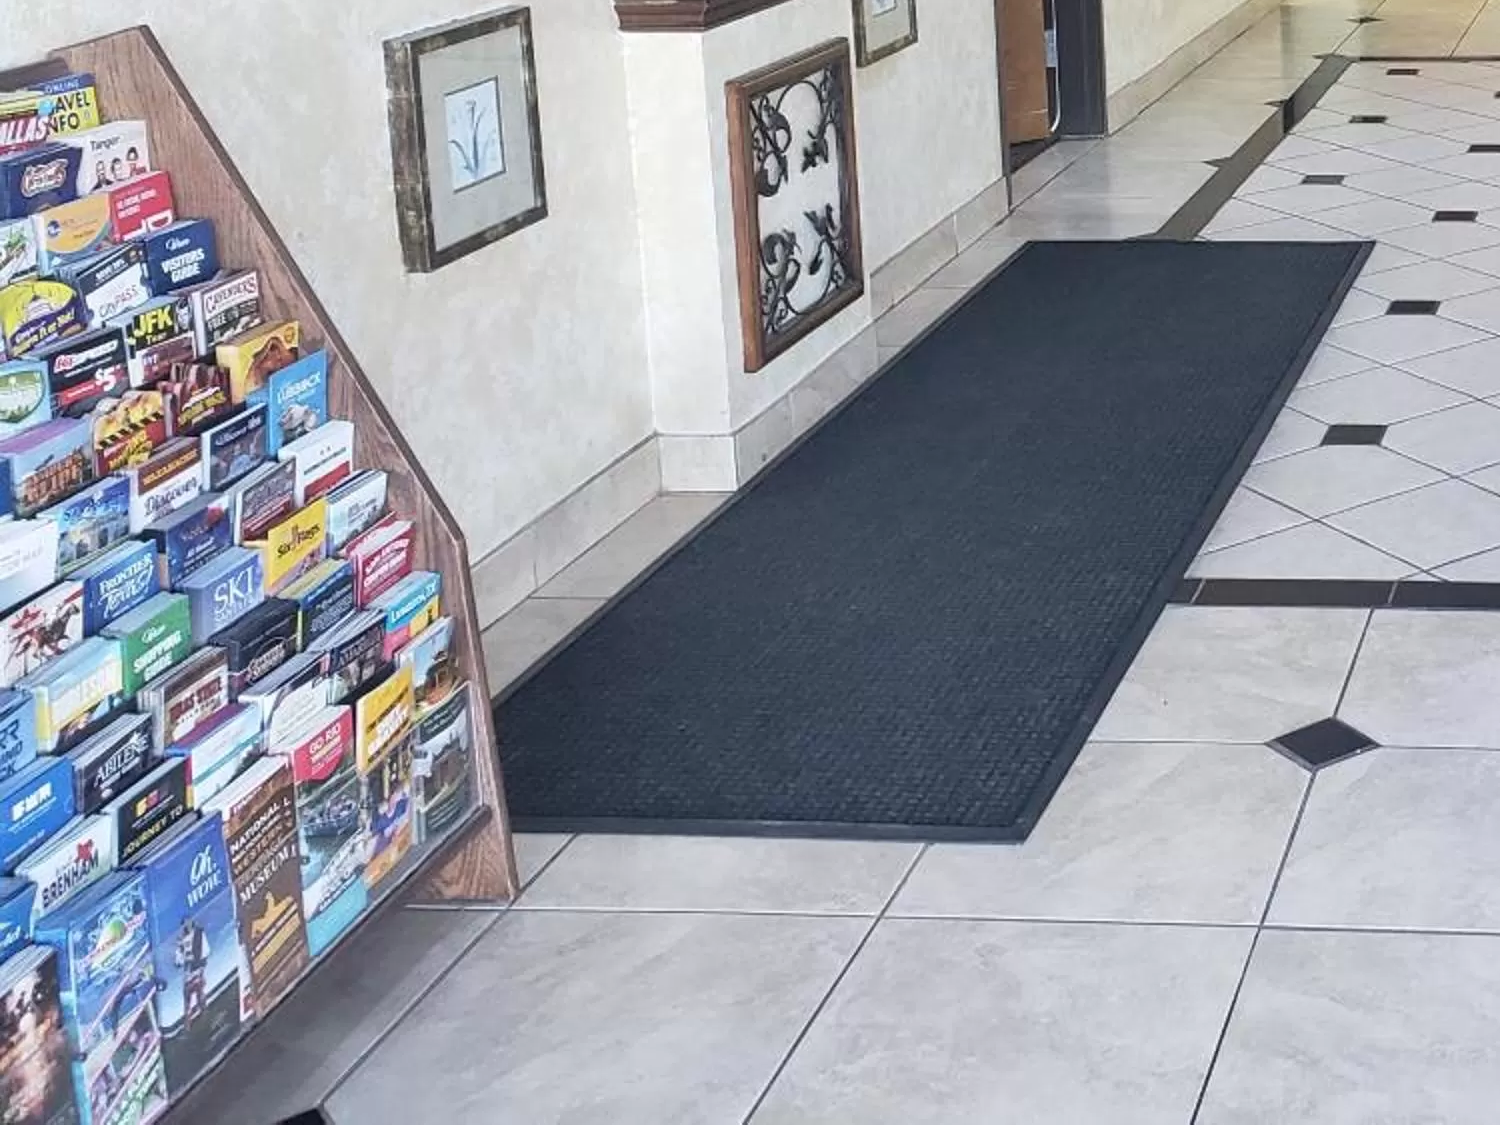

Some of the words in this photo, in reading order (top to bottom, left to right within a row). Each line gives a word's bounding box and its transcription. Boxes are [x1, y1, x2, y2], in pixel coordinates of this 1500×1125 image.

[90, 135, 122, 152] Tanger
[133, 304, 173, 337] JFK
[230, 800, 281, 856] NATIONAL
[42, 853, 100, 909] BRENHAM
[239, 850, 290, 903] MUSEUM
